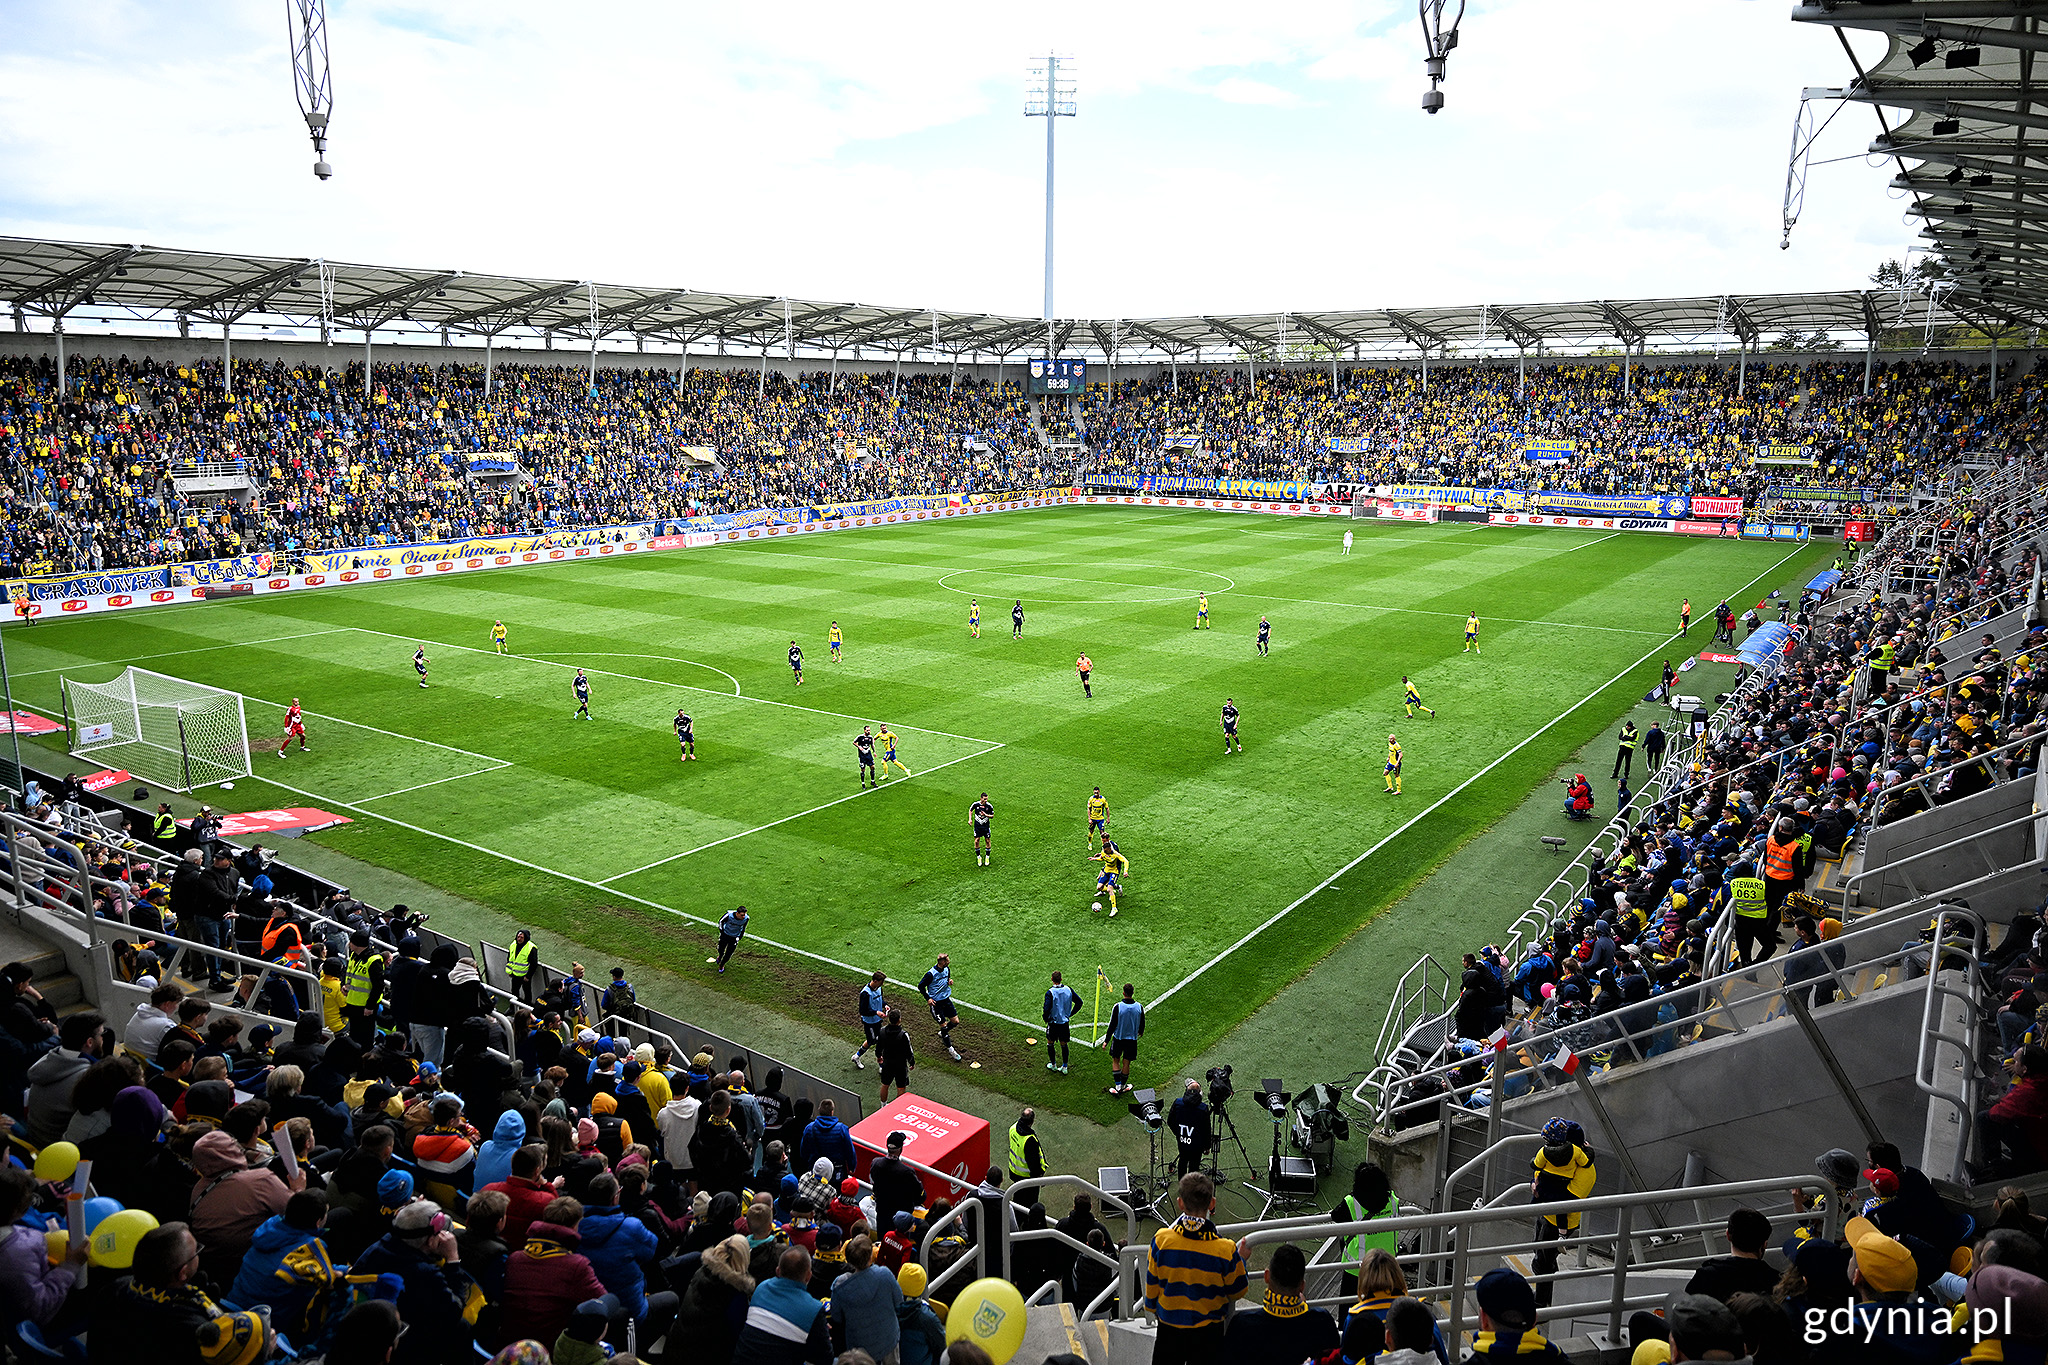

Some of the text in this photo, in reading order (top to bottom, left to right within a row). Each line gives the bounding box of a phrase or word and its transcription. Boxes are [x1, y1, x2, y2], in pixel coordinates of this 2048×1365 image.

[1047, 364, 1068, 376] 2 1
[1768, 446, 1801, 456] TCZEW
[233, 476, 244, 486] 14
[1155, 475, 1183, 491] FROM
[1218, 480, 1308, 499] ARKOWCY
[1428, 488, 1471, 504] GDYNIA
[1620, 519, 1669, 529] GDYNIA
[655, 538, 680, 548] Betclic
[322, 553, 348, 571] W
[33, 570, 166, 601] GRABÓWEK
[83, 776, 116, 791] Betclic
[1732, 881, 1764, 890] STEWARD
[1736, 889, 1757, 899] 063
[893, 1113, 949, 1138] Energa
[934, 1115, 960, 1127] GRUPA
[1179, 1124, 1195, 1137] TV
